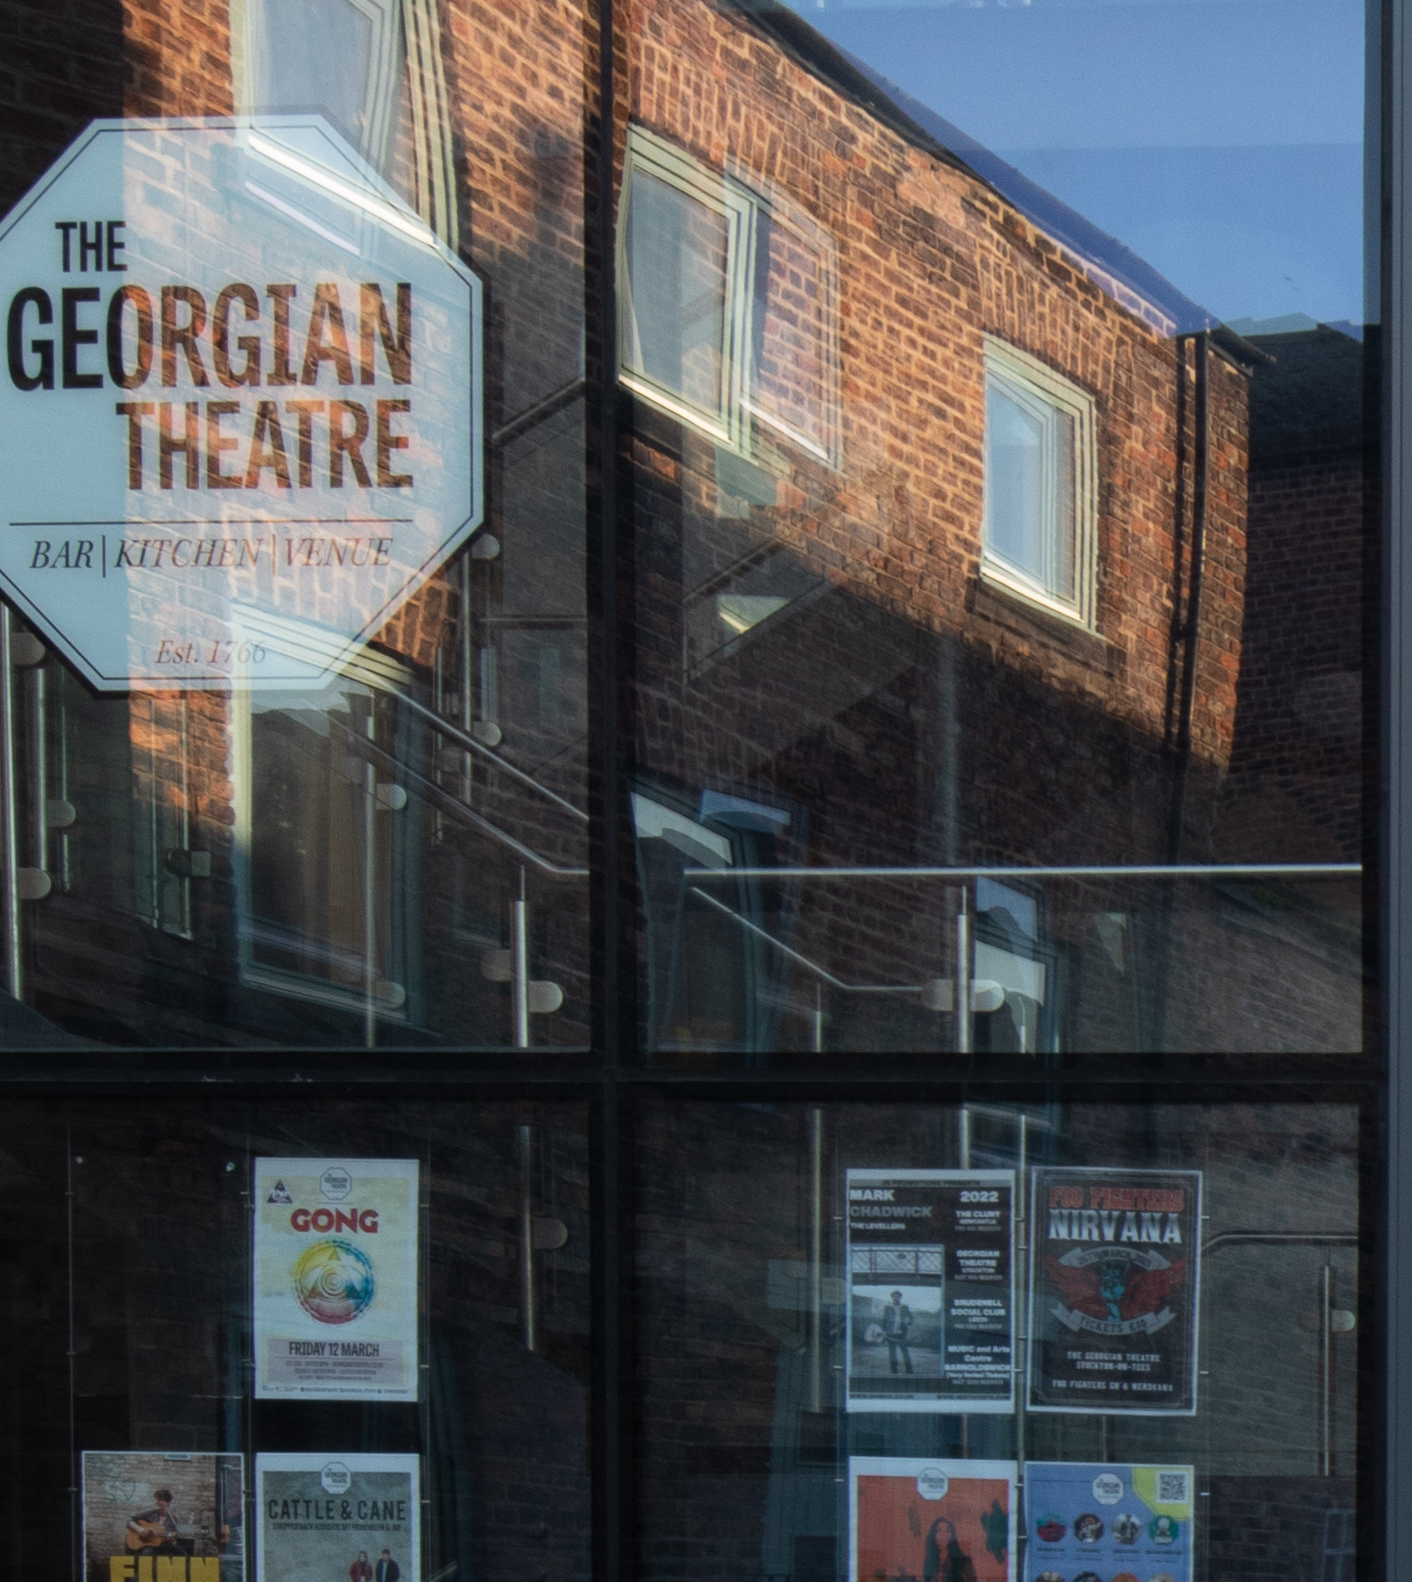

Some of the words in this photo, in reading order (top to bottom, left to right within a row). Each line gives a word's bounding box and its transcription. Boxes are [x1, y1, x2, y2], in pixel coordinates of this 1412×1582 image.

[56, 221, 127, 272] THE
[7, 282, 412, 390] GEORGIAN
[116, 399, 414, 490] THEATRE
[30, 539, 94, 570] BAR
[115, 538, 262, 569] KITCHEN
[284, 537, 394, 568] VENUE
[155, 640, 200, 665] Est.
[208, 639, 267, 665] 1766
[850, 1189, 895, 1201] MARK
[960, 1190, 999, 1202] 2022
[1049, 1186, 1083, 1208] FOO
[1090, 1186, 1184, 1212] FIGHTERS
[290, 1208, 379, 1234] GONG
[850, 1206, 933, 1217] CHADWICK
[956, 1210, 972, 1218] THE
[1048, 1208, 1182, 1244] NIRVANA
[959, 1259, 997, 1267] THEATRE
[951, 1308, 982, 1316] SOCIAL
[1080, 1315, 1123, 1333] TICKETS
[289, 1341, 326, 1356] FRIDAY
[329, 1342, 340, 1356] 12
[341, 1343, 380, 1357] MARCH
[1067, 1351, 1082, 1359] THE
[1085, 1352, 1123, 1360] GEORGIAN
[1126, 1353, 1161, 1362] THEATRE
[1052, 1379, 1067, 1388] FOO
[1069, 1380, 1106, 1389] FIGHTERS
[268, 1499, 335, 1520] CATTLE
[340, 1500, 352, 1521] &
[357, 1500, 406, 1521] CANE
